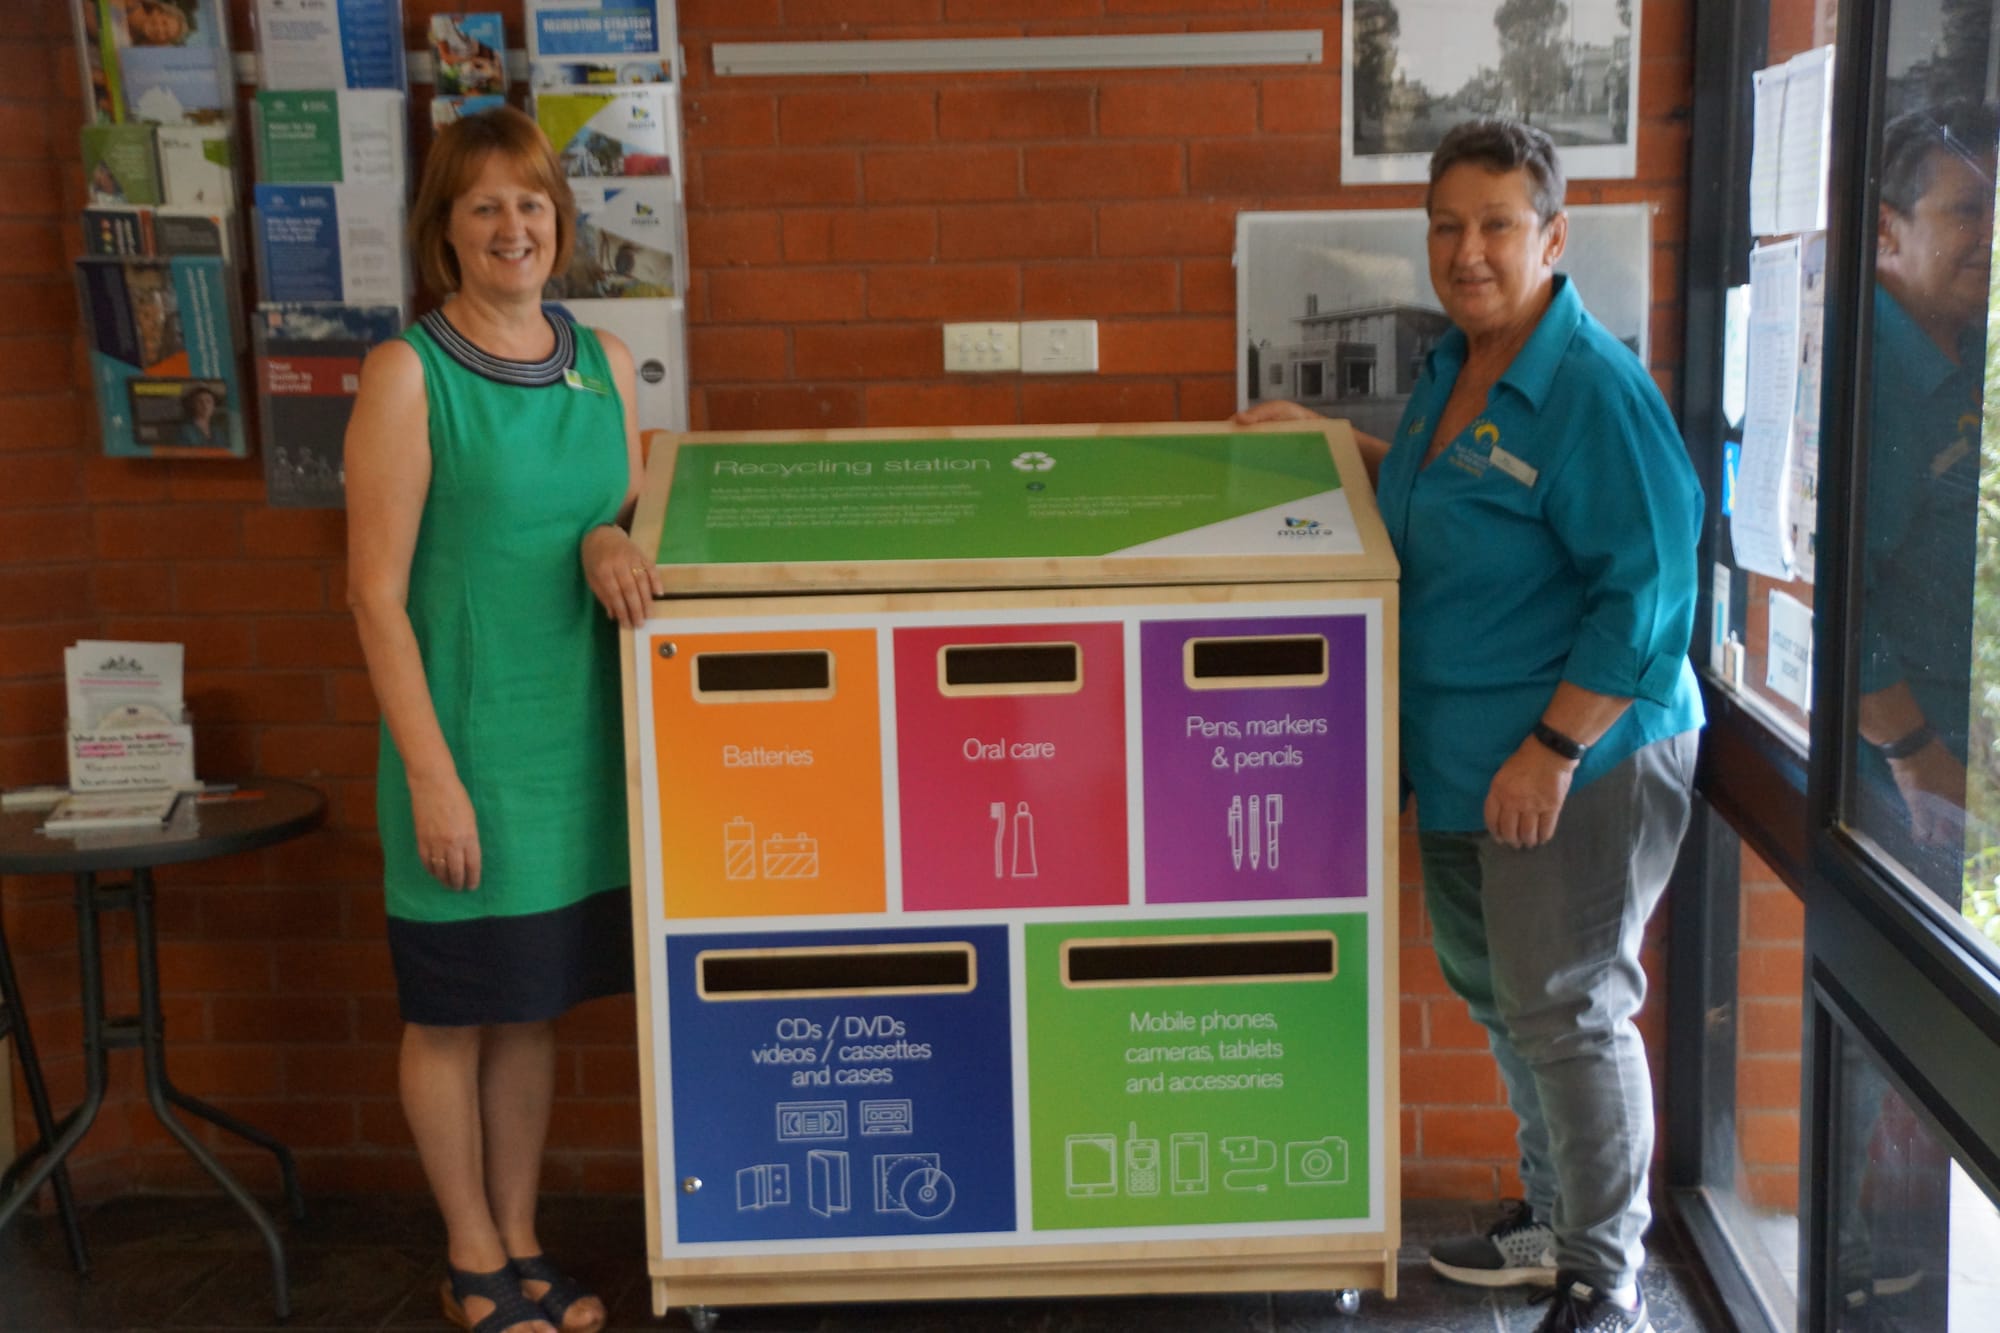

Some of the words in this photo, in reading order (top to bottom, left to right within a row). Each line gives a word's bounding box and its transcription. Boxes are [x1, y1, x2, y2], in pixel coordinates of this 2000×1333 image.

[604, 15, 652, 32] STRATEGY
[714, 459, 872, 477] Recycling
[884, 457, 991, 473] station
[1186, 715, 1242, 739] Pens,
[1246, 713, 1328, 736] markers
[722, 744, 815, 768] Batteries
[963, 737, 1006, 760] Oral
[1009, 742, 1056, 759] care
[1211, 746, 1230, 768] &
[1234, 744, 1304, 773] pencils
[776, 1018, 823, 1040] CDs
[844, 1015, 906, 1038] DVDs
[1129, 1010, 1197, 1032] Mobile
[1202, 1009, 1278, 1037] phones,
[751, 1042, 817, 1064] videos
[838, 1039, 933, 1062] cassettes
[1125, 1045, 1214, 1063] cameras,
[1218, 1038, 1285, 1060] tablets
[791, 1064, 831, 1087] and
[835, 1067, 894, 1085] cases
[1126, 1071, 1165, 1093] and
[1168, 1068, 1285, 1092] accessories
